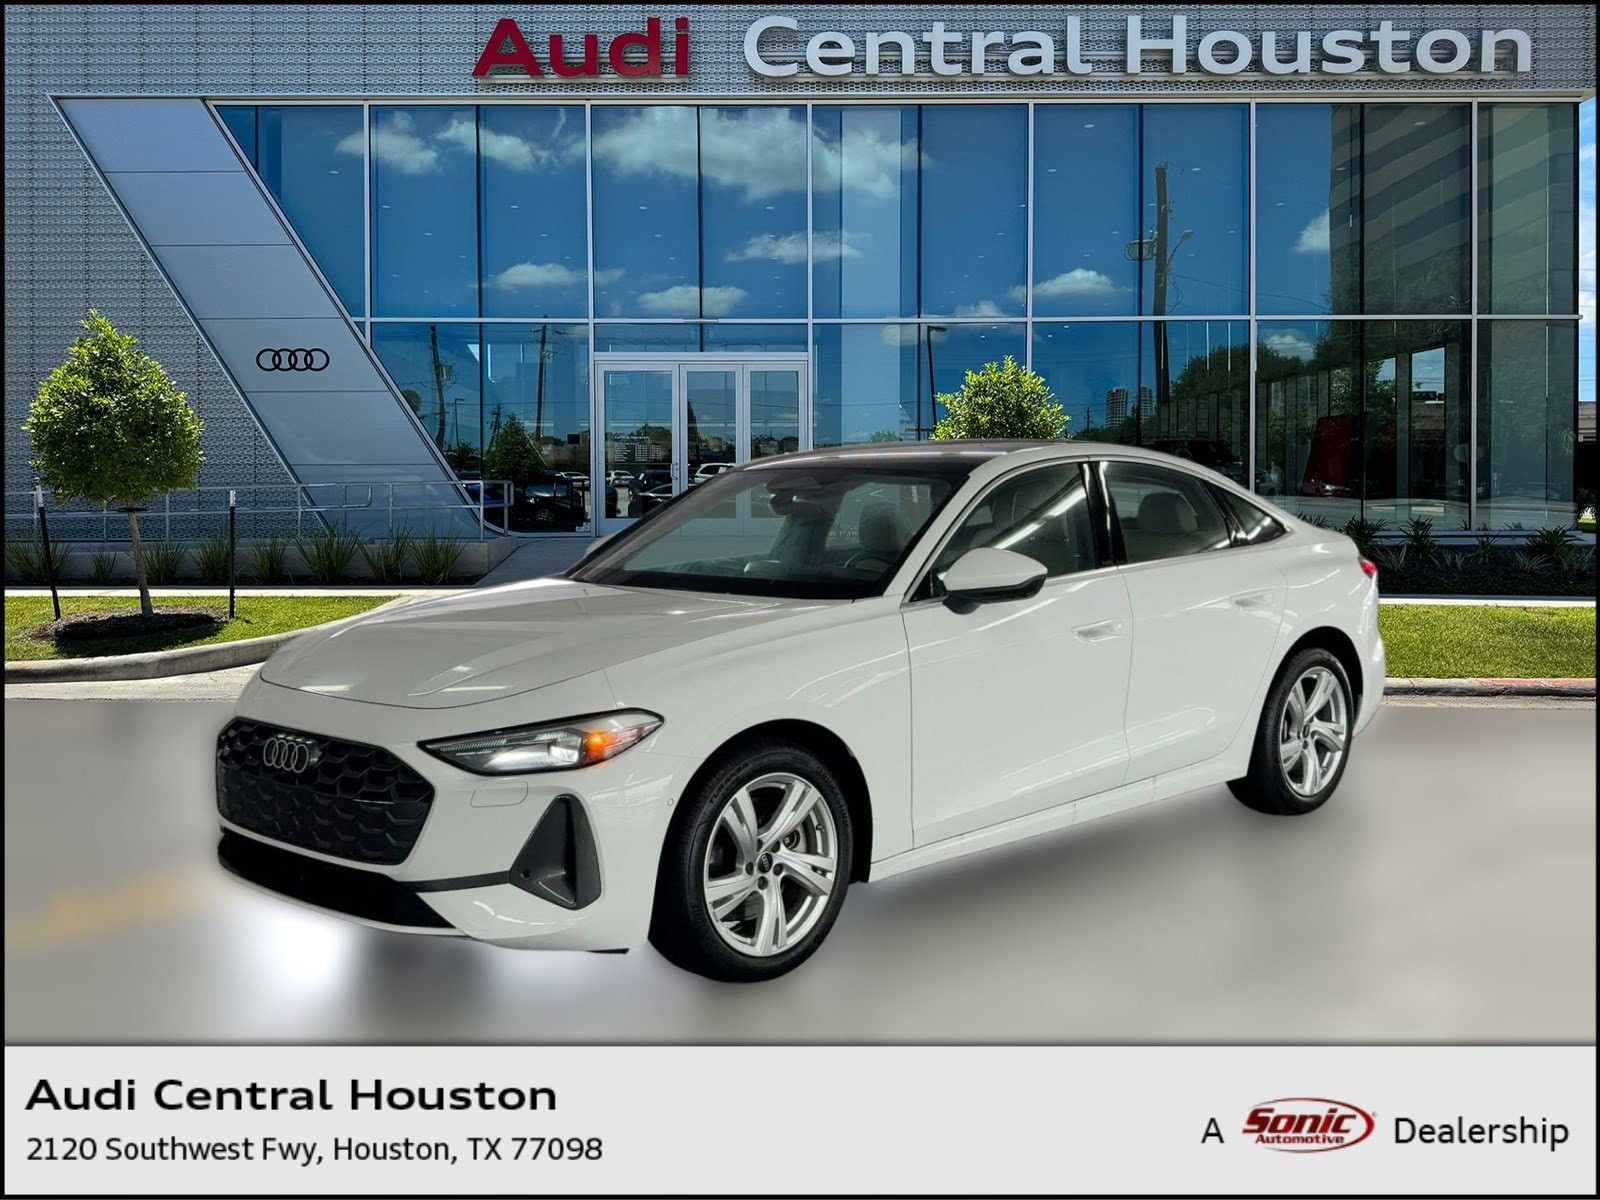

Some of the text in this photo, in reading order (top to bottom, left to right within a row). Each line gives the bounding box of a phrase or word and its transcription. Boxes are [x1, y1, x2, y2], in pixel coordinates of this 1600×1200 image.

[472, 15, 1531, 77] Audi Central Houston
